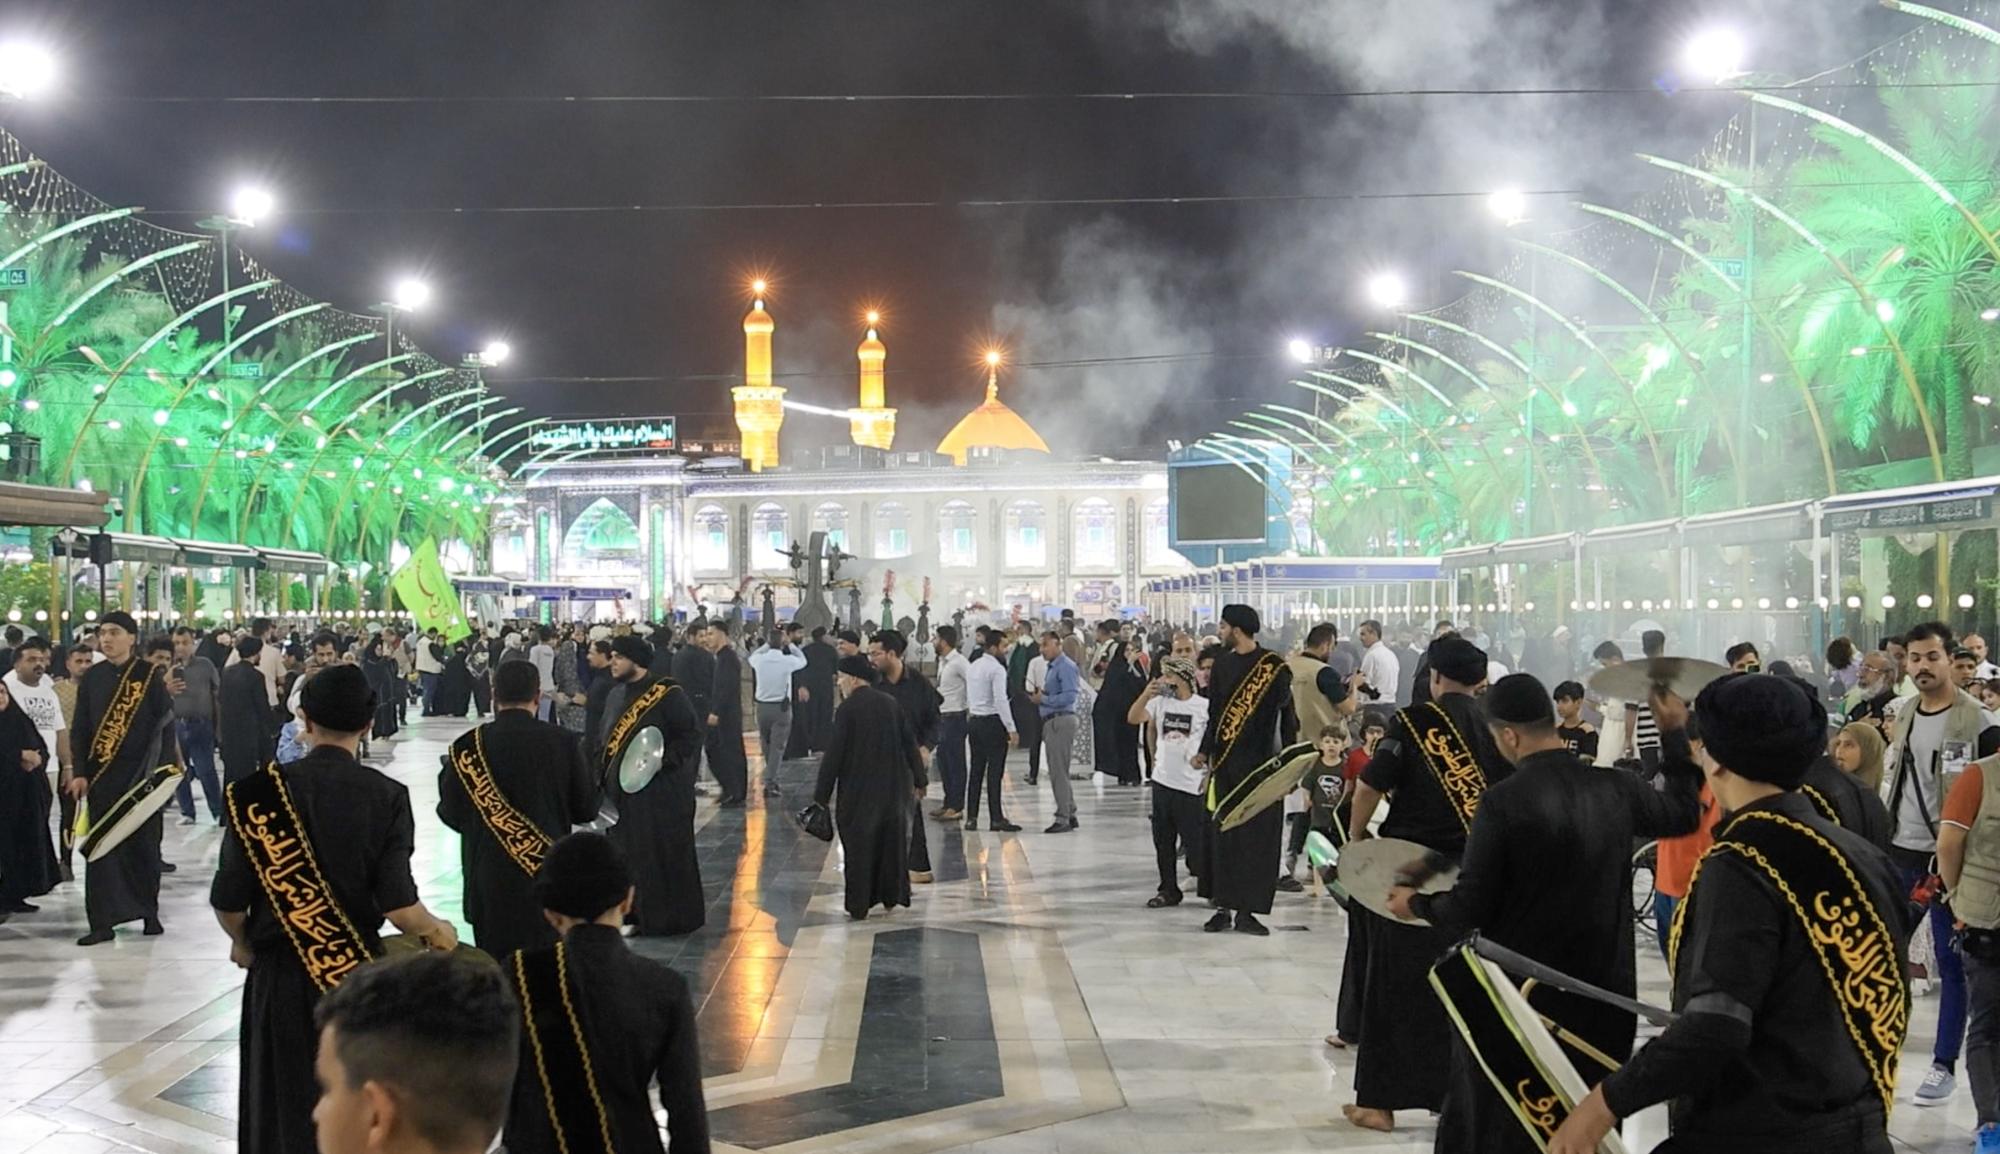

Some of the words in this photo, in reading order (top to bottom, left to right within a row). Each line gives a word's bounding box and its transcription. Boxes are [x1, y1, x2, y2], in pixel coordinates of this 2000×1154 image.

[601, 425, 634, 447] عليك
[634, 424, 672, 446] السلام
[459, 750, 492, 796] الطفوف
[1425, 728, 1474, 781] الطفوف
[246, 803, 305, 879] الطفوف
[266, 867, 341, 944] عطاشى
[1813, 891, 1884, 986] الطفوف
